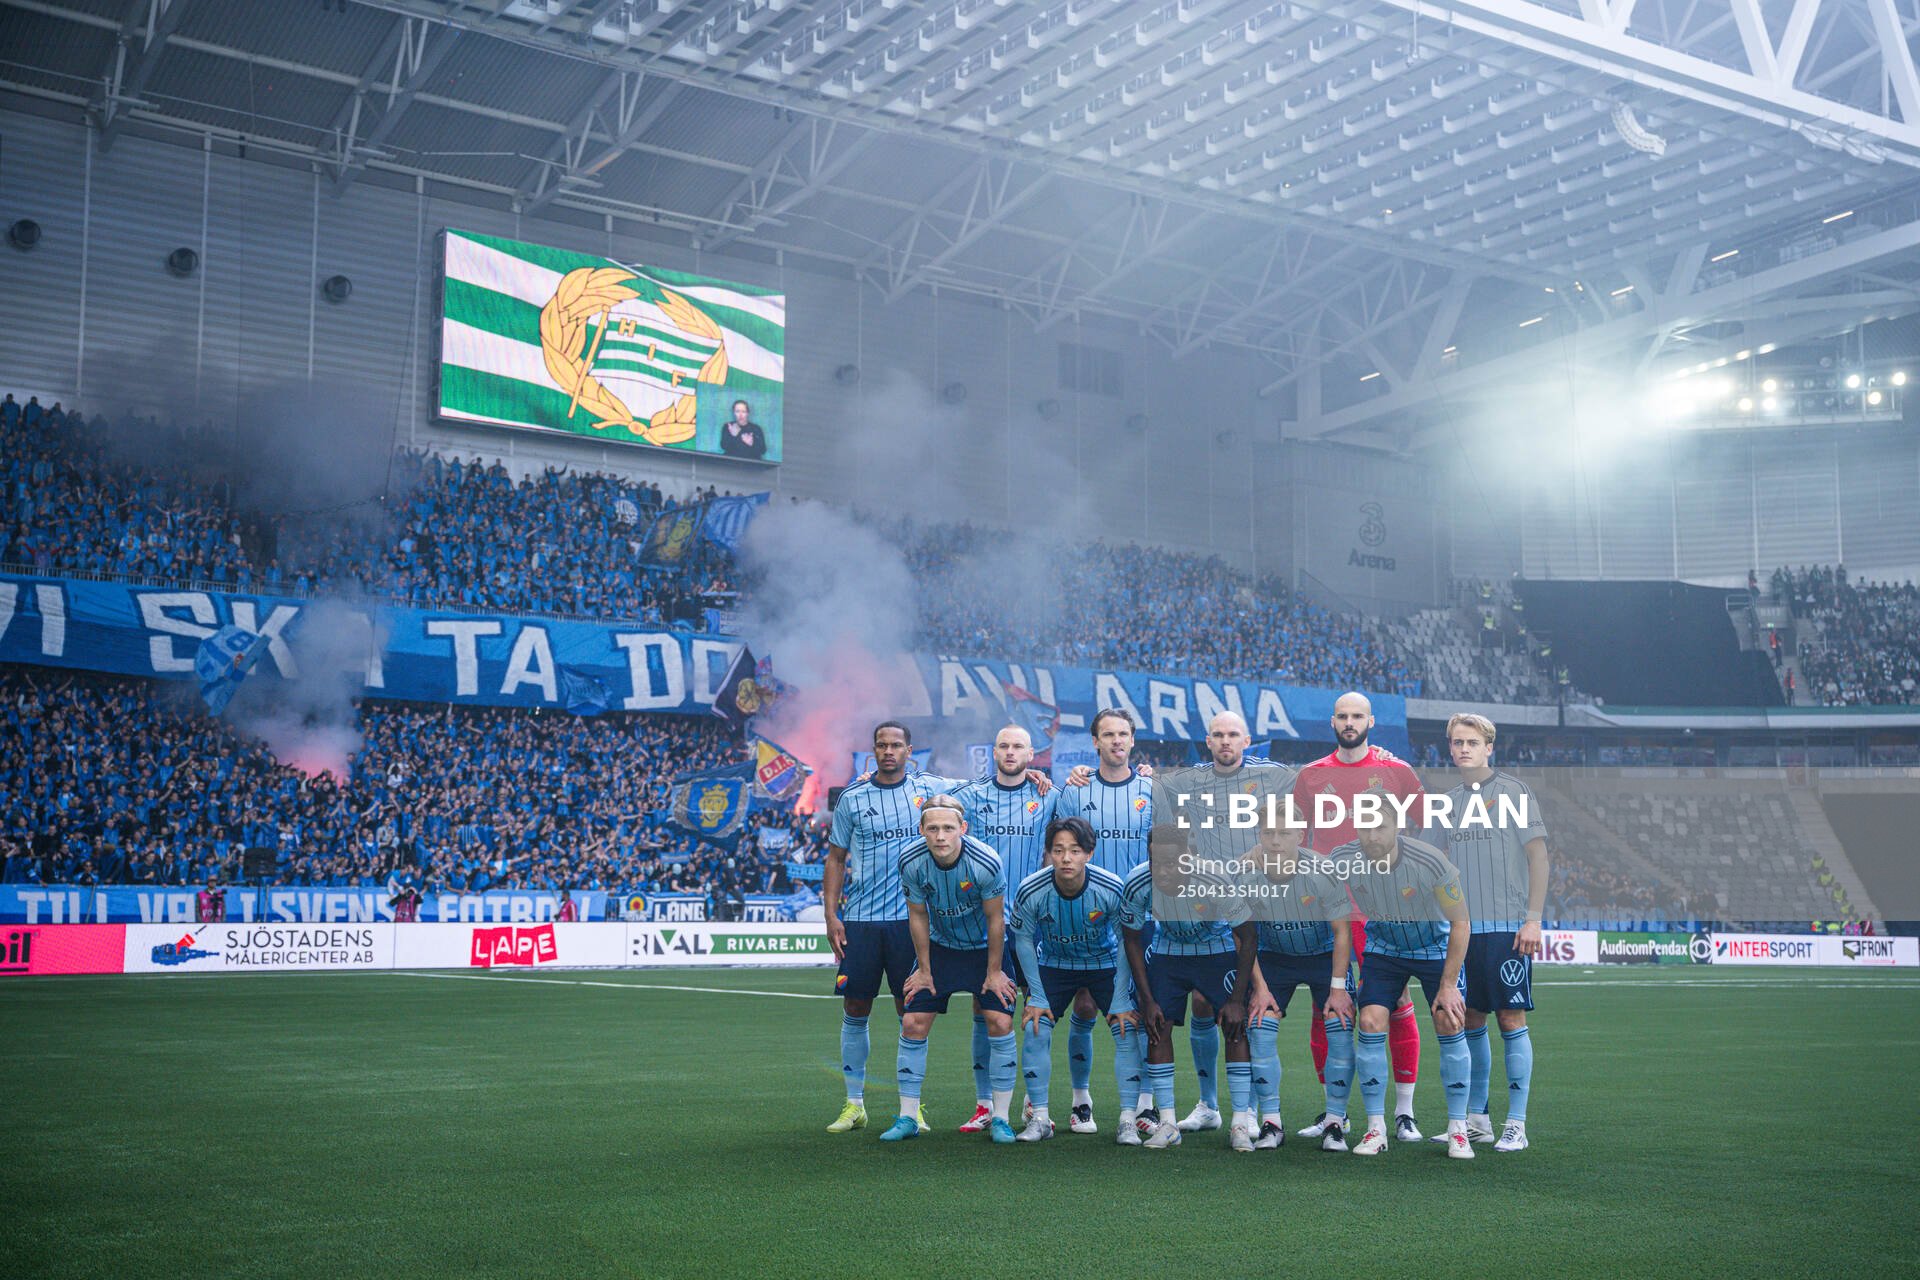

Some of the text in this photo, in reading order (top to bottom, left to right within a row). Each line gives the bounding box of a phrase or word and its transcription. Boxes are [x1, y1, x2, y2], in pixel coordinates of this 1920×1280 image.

[1347, 547, 1396, 571] Arena
[427, 621, 558, 702] TA
[984, 825, 1035, 838] MOBILL
[226, 926, 373, 949] SJÖSTADENS
[475, 933, 554, 958] LAPE
[632, 930, 708, 956] RIVAL
[727, 938, 818, 951] RIVARE.NU
[1600, 939, 1688, 956] AudicomPendax
[1729, 940, 1814, 958] INTERSPORT
[1861, 940, 1895, 957] FRONT
[225, 950, 374, 965] MÅLERICENTER AB
